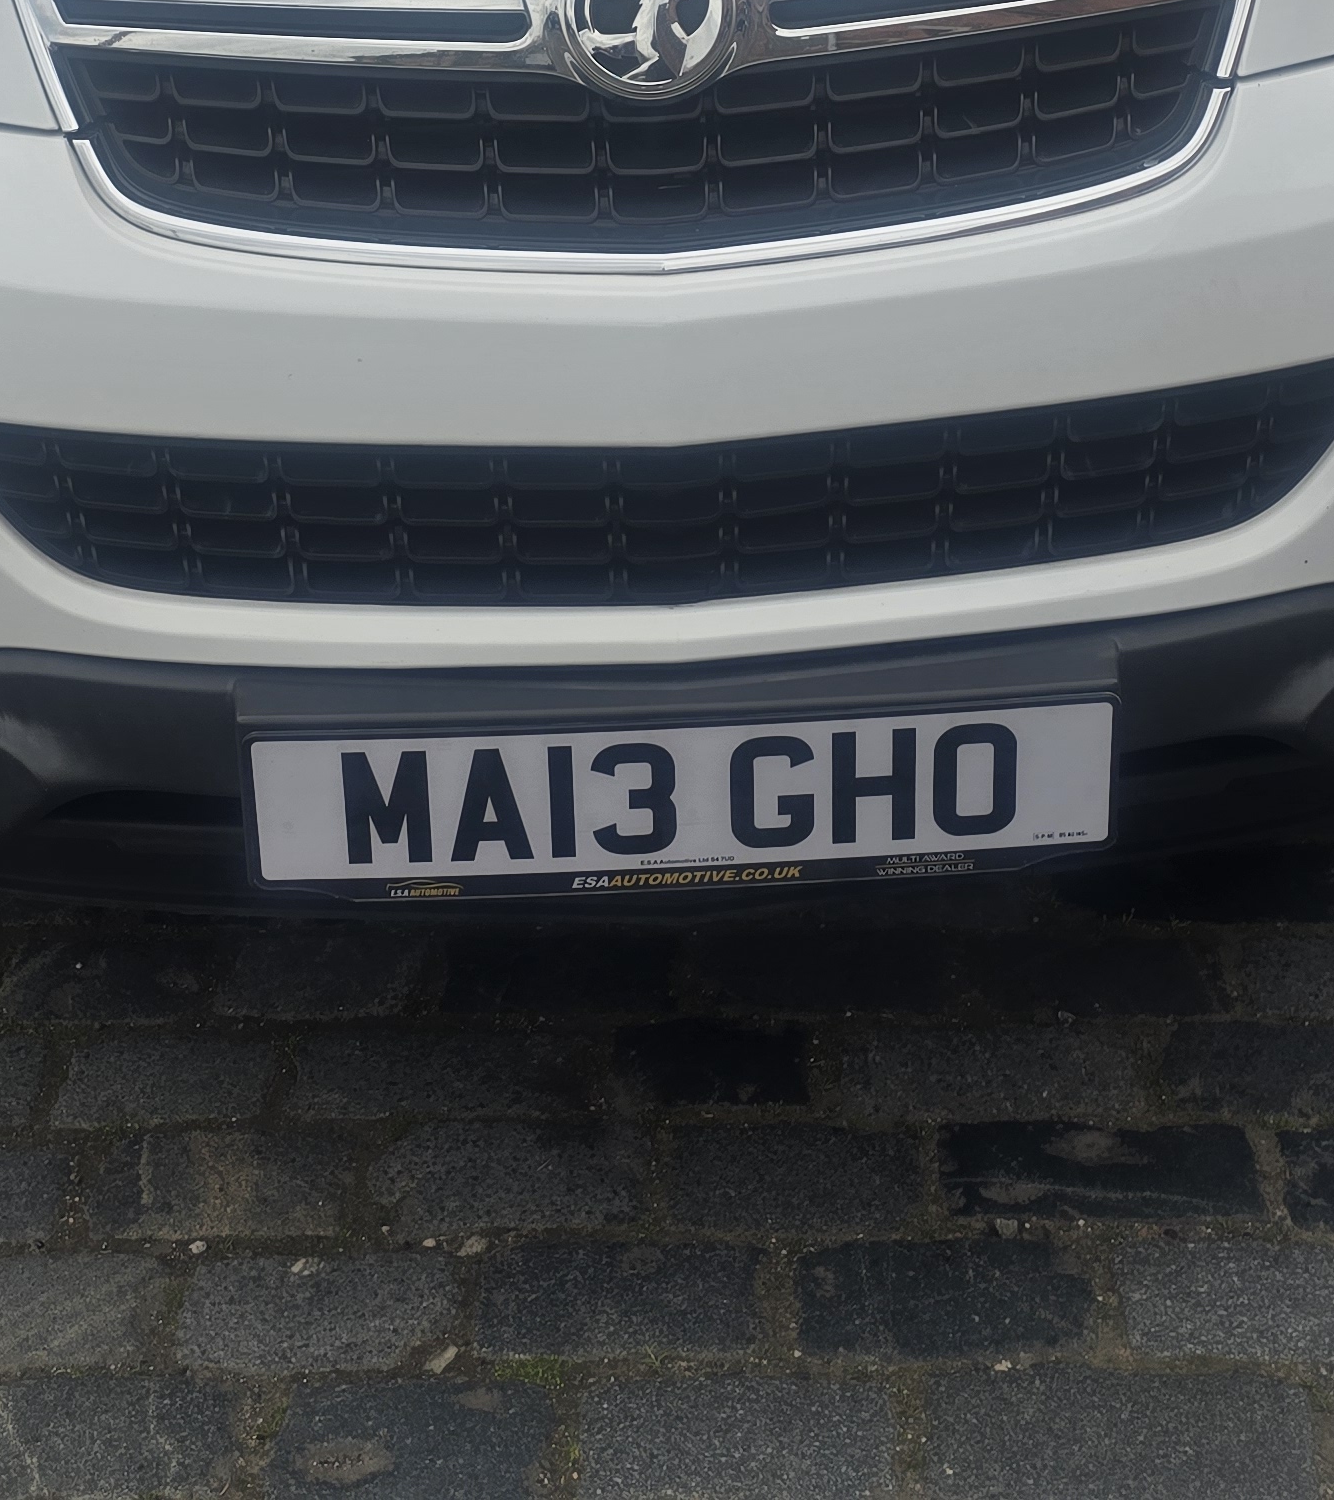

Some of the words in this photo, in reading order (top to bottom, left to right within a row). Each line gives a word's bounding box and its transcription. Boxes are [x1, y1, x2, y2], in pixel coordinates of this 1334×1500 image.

[339, 742, 678, 865] MA13
[728, 722, 1018, 849] GHO
[886, 855, 920, 864] MULTI
[922, 853, 965, 863] AWARD
[876, 865, 926, 876] WINNING
[928, 862, 974, 873] DEALER
[571, 865, 804, 889] ESAAUTOMOTIVE.CO.UK
[409, 887, 460, 897] AUTOMOTIVE
